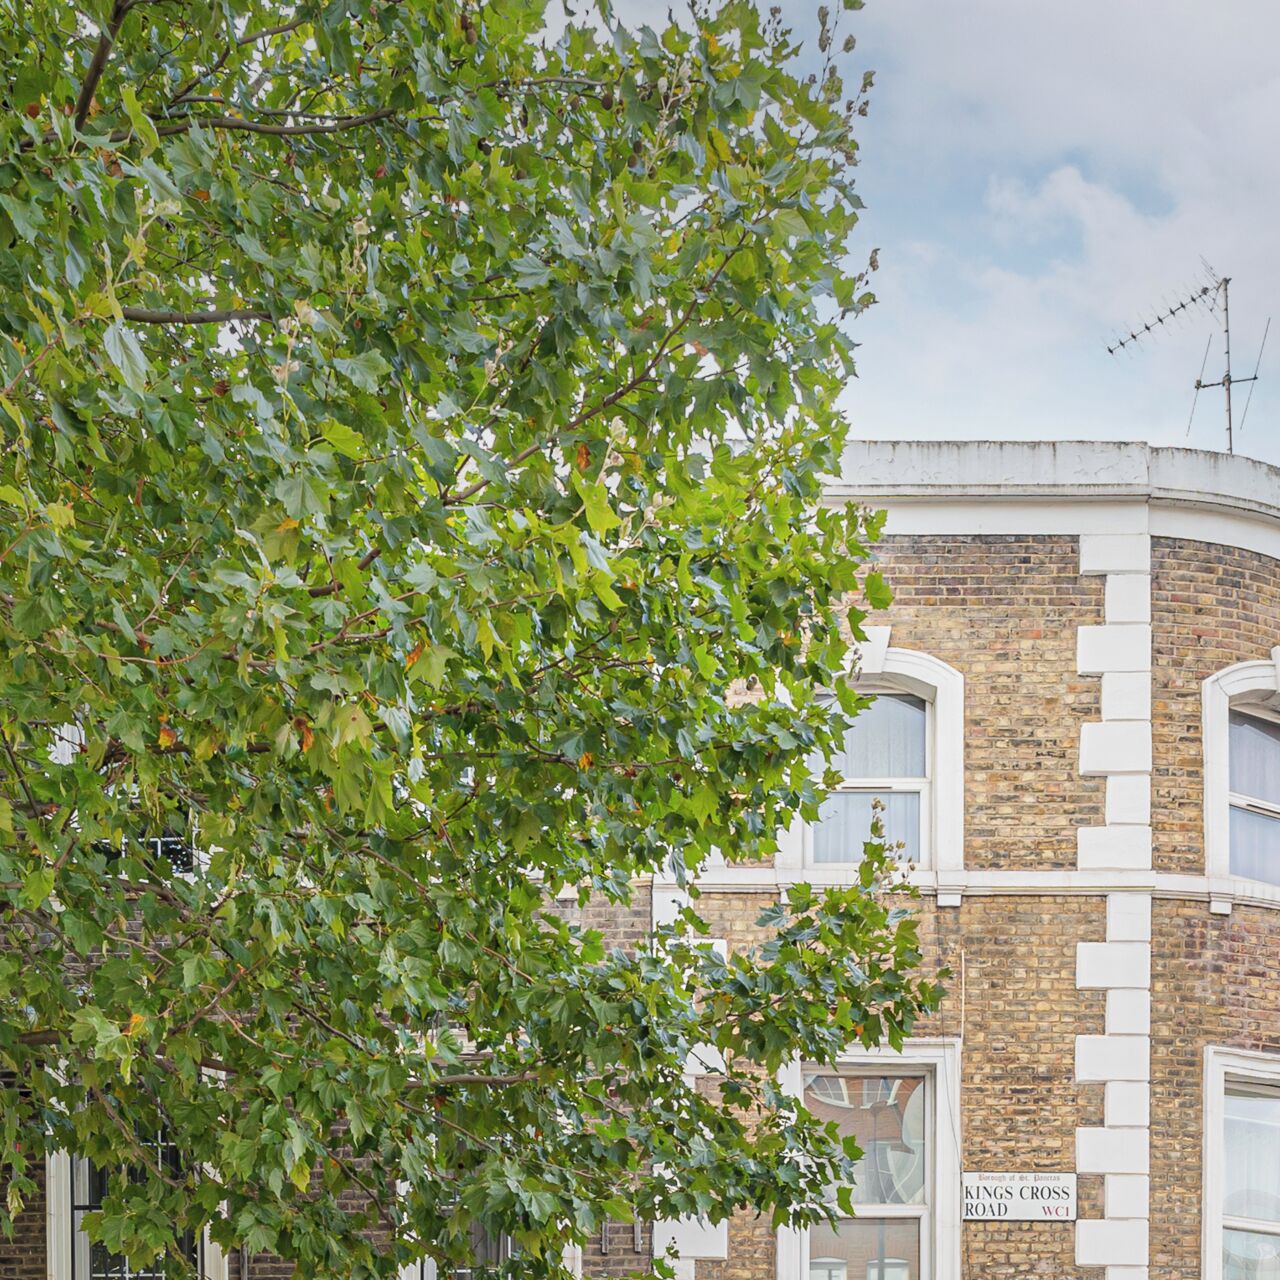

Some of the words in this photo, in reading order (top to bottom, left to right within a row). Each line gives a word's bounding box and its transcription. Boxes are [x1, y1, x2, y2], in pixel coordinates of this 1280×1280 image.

[965, 1185, 1013, 1200] KINGS
[1020, 1185, 1070, 1200] CROSS
[965, 1202, 1008, 1216] ROAD
[1042, 1206, 1069, 1217] WC1
